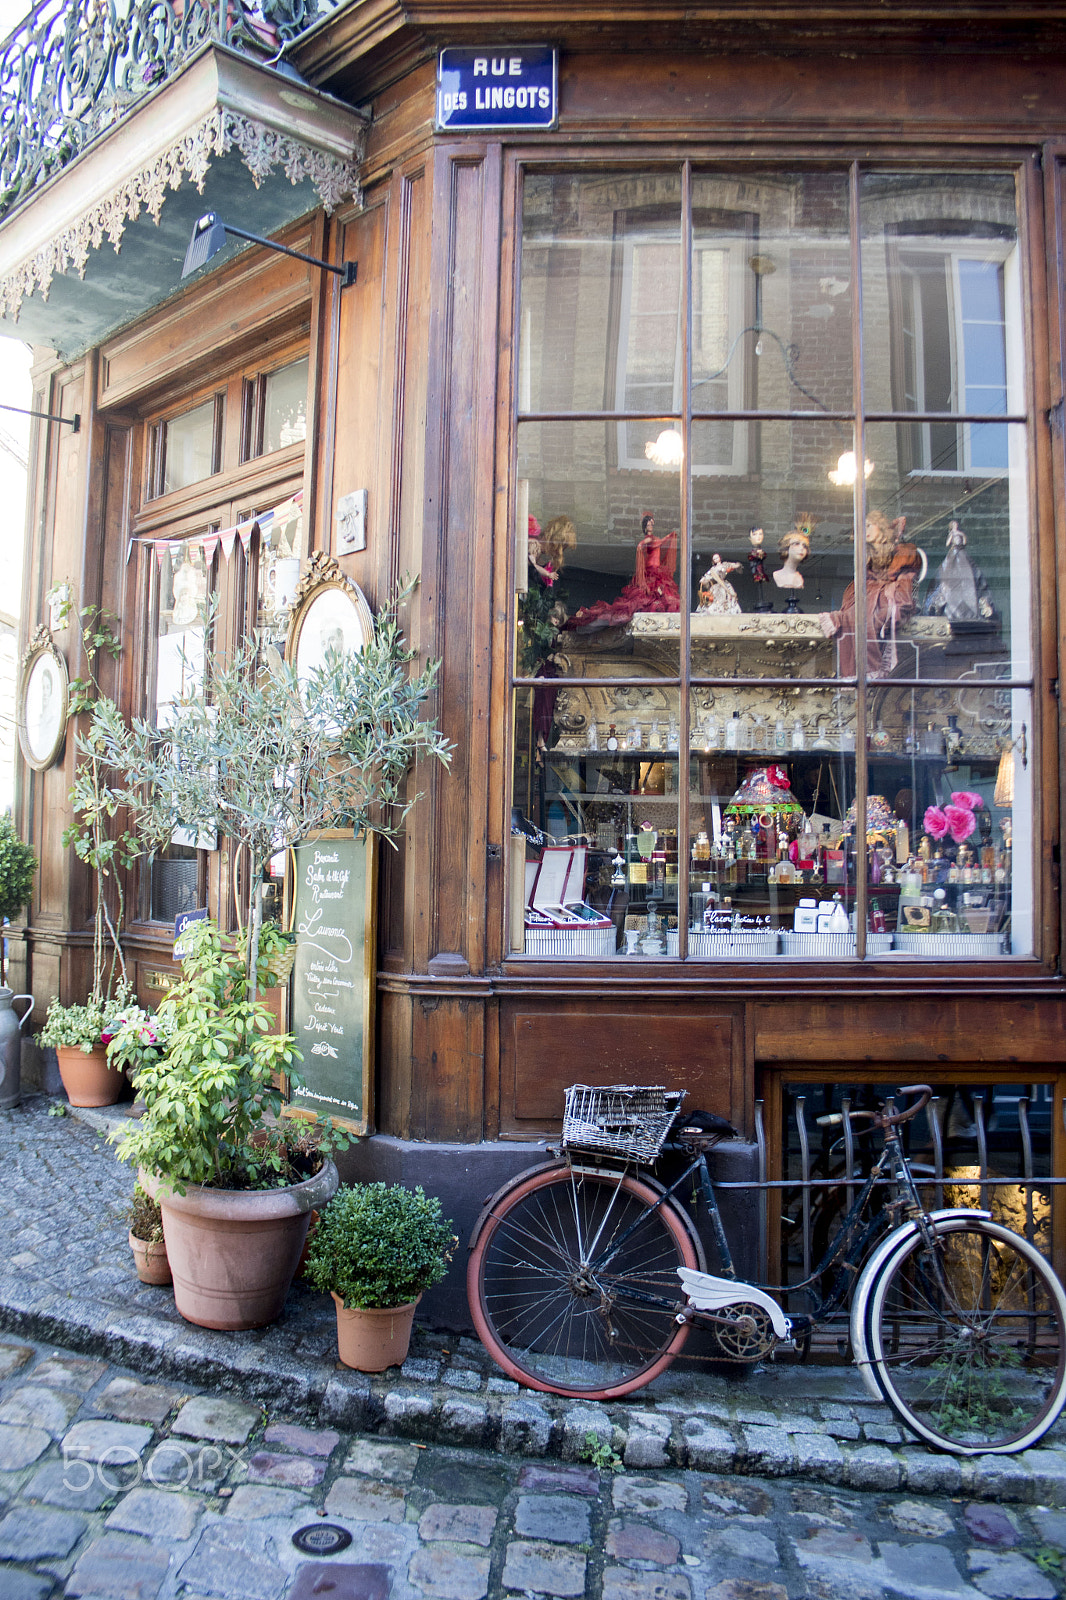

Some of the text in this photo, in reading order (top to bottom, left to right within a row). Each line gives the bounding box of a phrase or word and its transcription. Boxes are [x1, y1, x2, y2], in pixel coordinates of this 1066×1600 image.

[473, 57, 522, 76] RUE
[443, 86, 550, 111] DES LINGOTS
